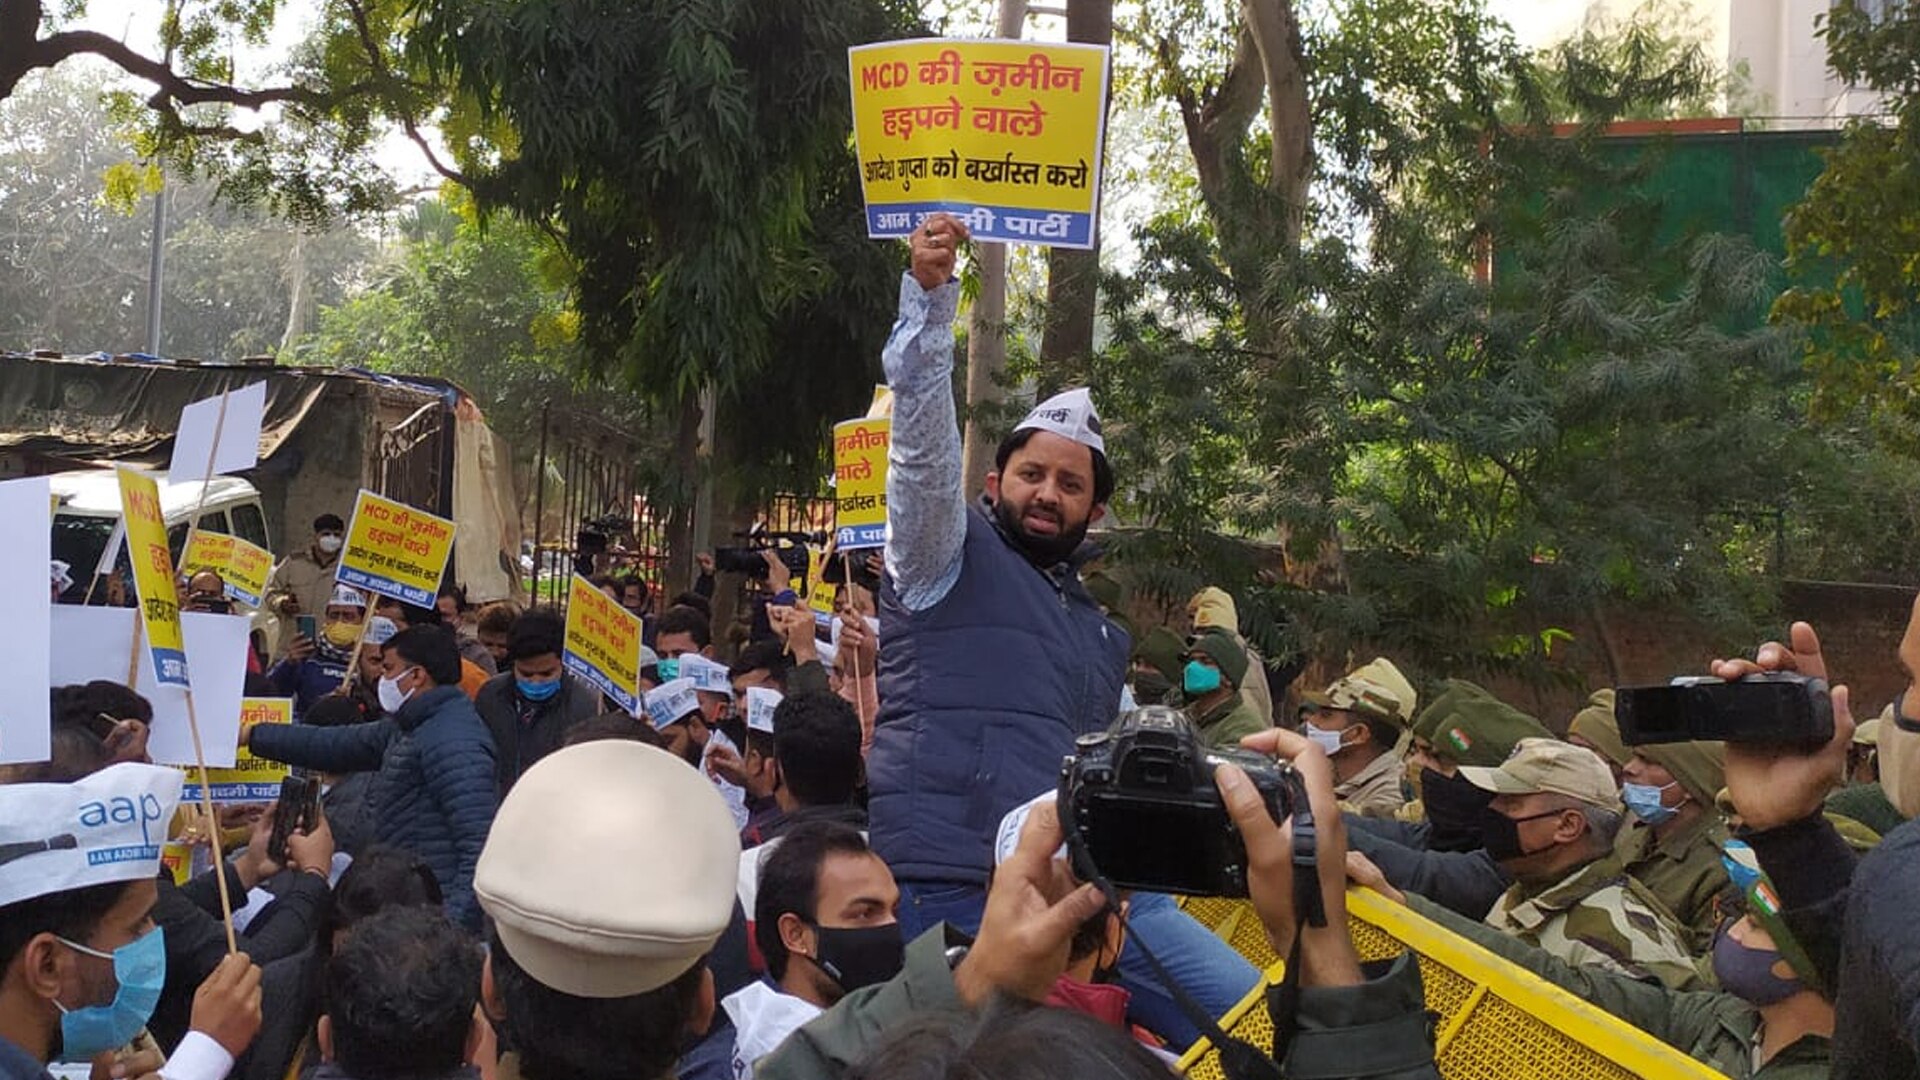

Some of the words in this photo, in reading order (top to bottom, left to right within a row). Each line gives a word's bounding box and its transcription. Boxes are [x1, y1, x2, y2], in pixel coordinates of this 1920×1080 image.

[862, 63, 909, 91] MCD
[918, 50, 963, 85] की
[972, 53, 1084, 96] ज़मीन
[883, 97, 963, 140] हड़पने
[972, 100, 1047, 136] वाले
[866, 154, 895, 182] आदेश
[898, 157, 928, 192] गुप्ता
[932, 149, 959, 179] को
[965, 152, 1041, 184] बर्खास्त
[1046, 159, 1087, 188] करो
[877, 213, 911, 229] आम
[1003, 214, 1071, 238] पार्टी
[363, 502, 389, 521] MCD
[79, 793, 161, 848] aap
